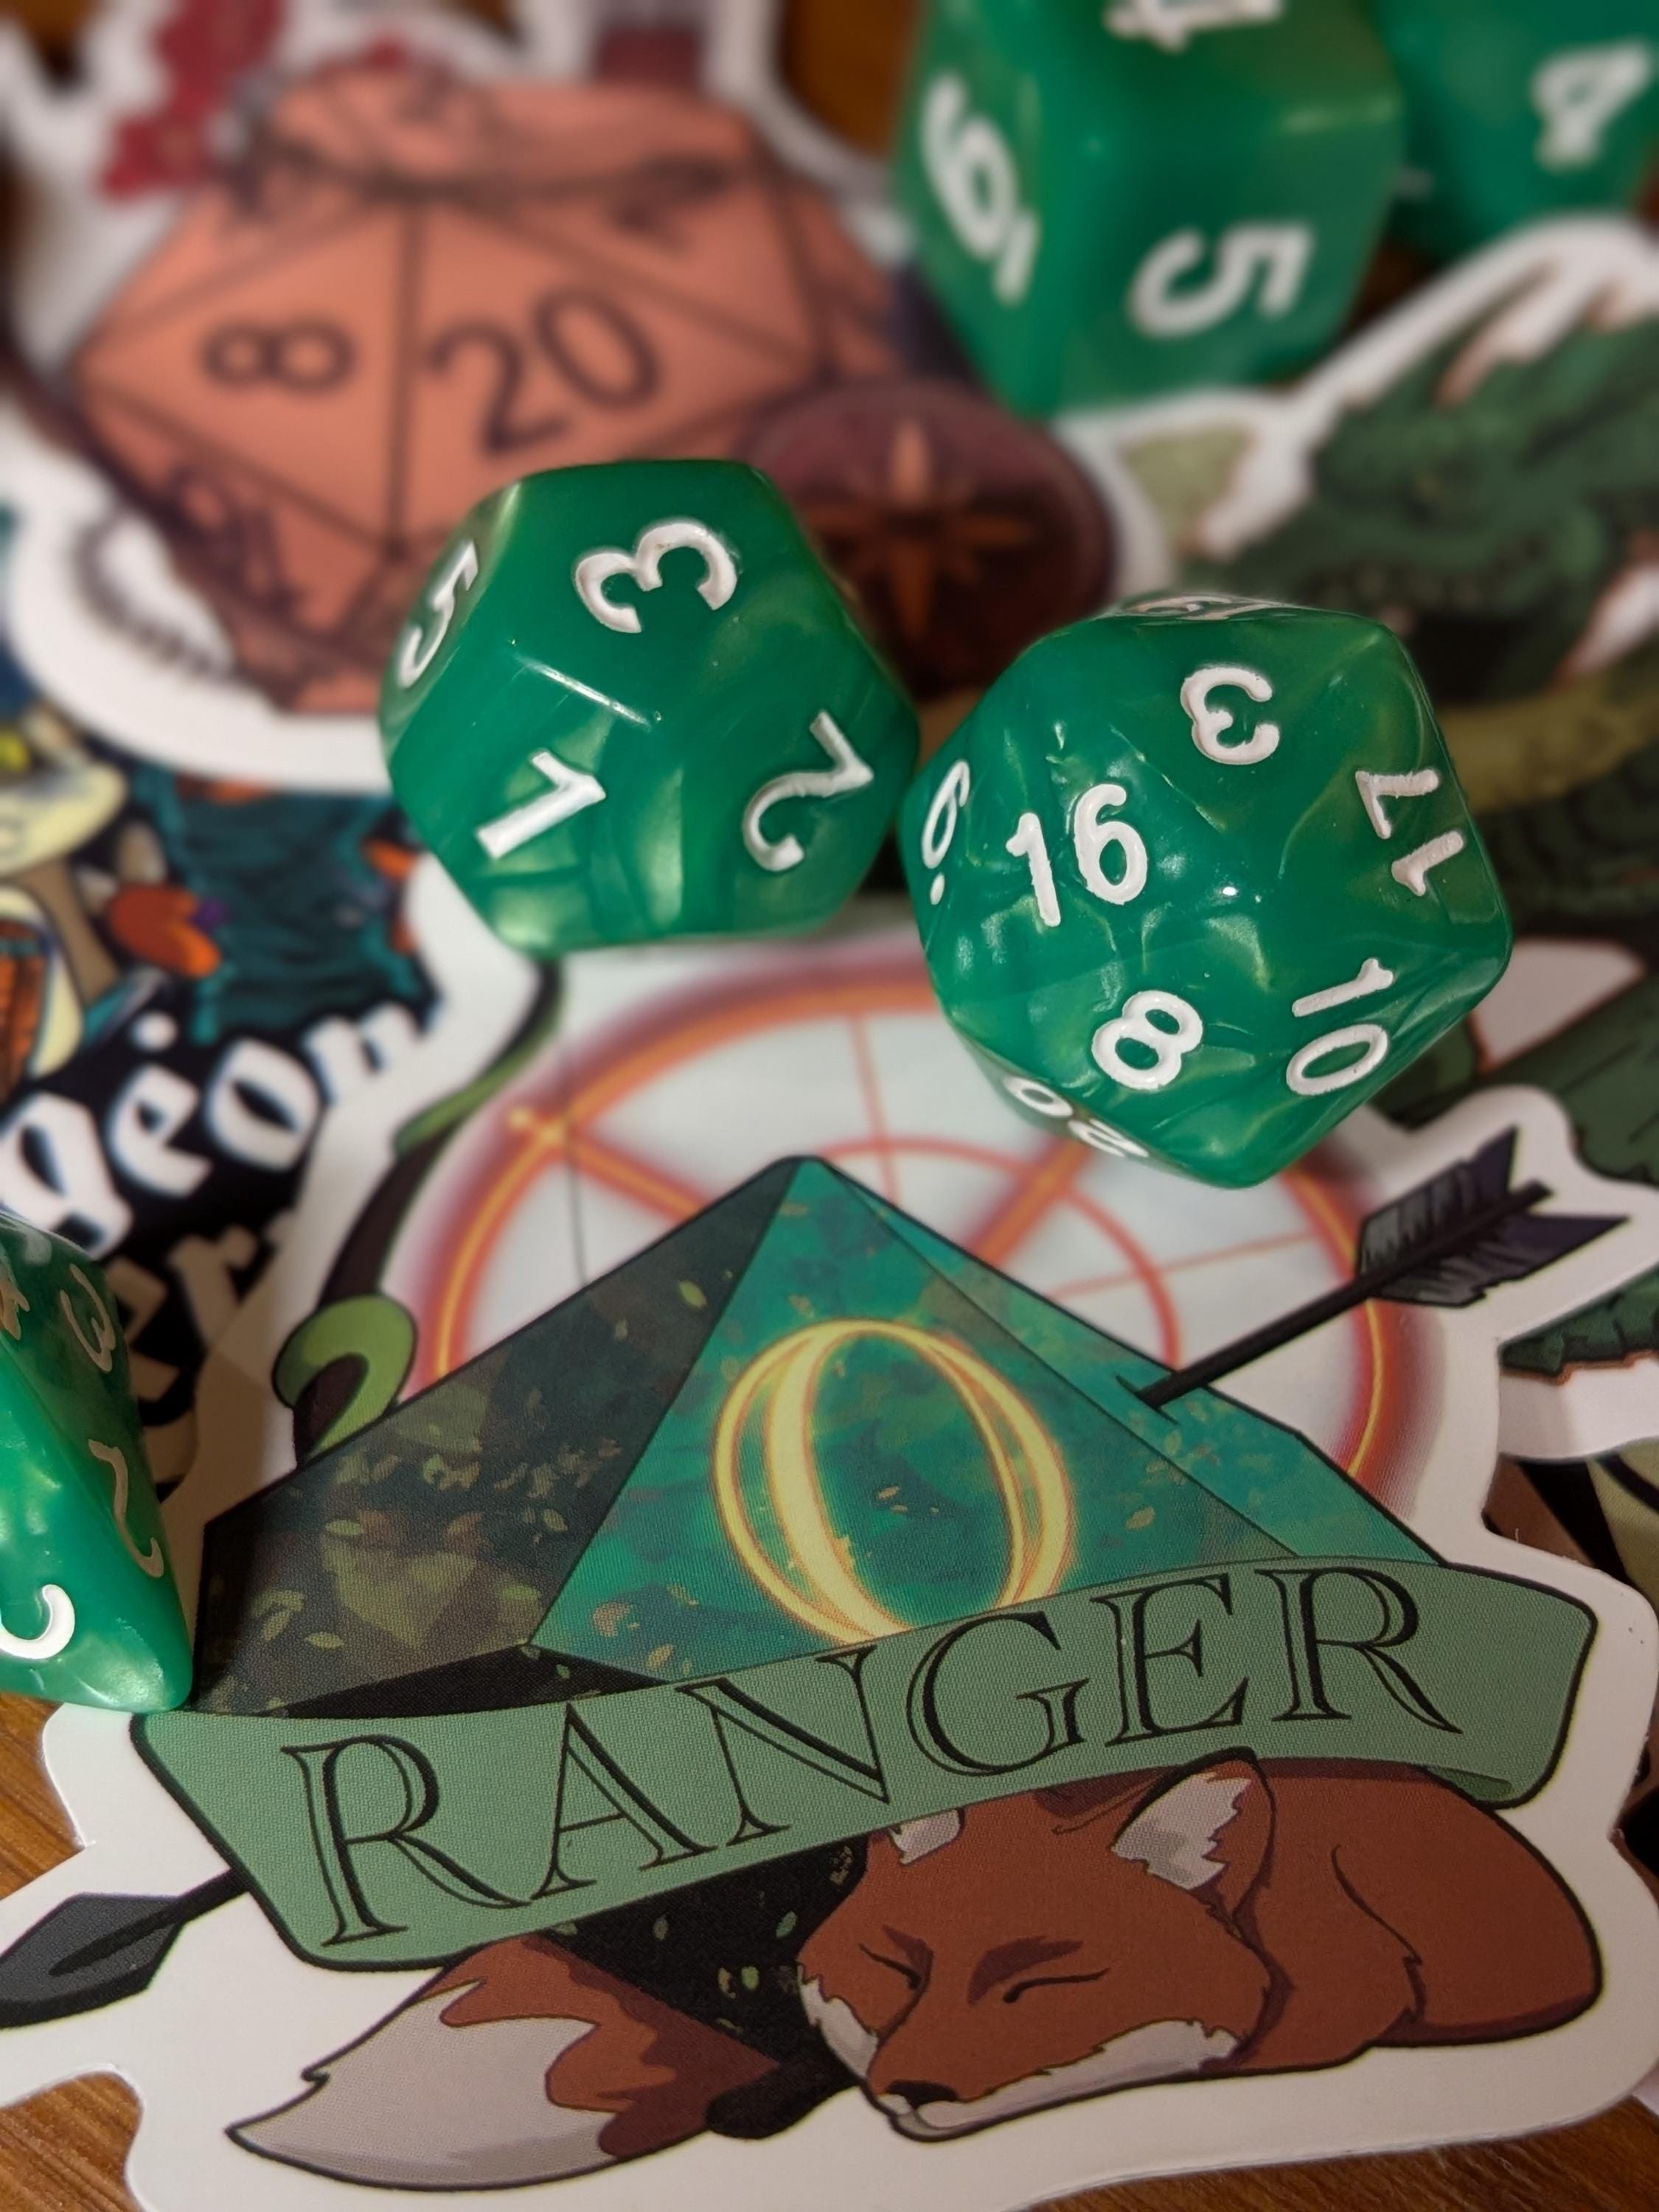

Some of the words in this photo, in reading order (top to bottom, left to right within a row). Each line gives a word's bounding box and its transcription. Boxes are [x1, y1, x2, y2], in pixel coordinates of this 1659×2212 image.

[1530, 35, 1652, 174] 4
[1127, 218, 1313, 339] 5
[199, 319, 355, 397] 8
[429, 288, 664, 459] 20
[397, 539, 479, 689] 5
[575, 519, 737, 633] 3
[1180, 664, 1280, 765] 3
[476, 749, 606, 860] 1
[742, 709, 874, 872] 2
[1006, 784, 1148, 927] 16
[1355, 768, 1464, 897] 17
[1091, 989, 1203, 1091] 8
[1286, 958, 1394, 1096] 10
[278, 1563, 1464, 1947] RANGER
